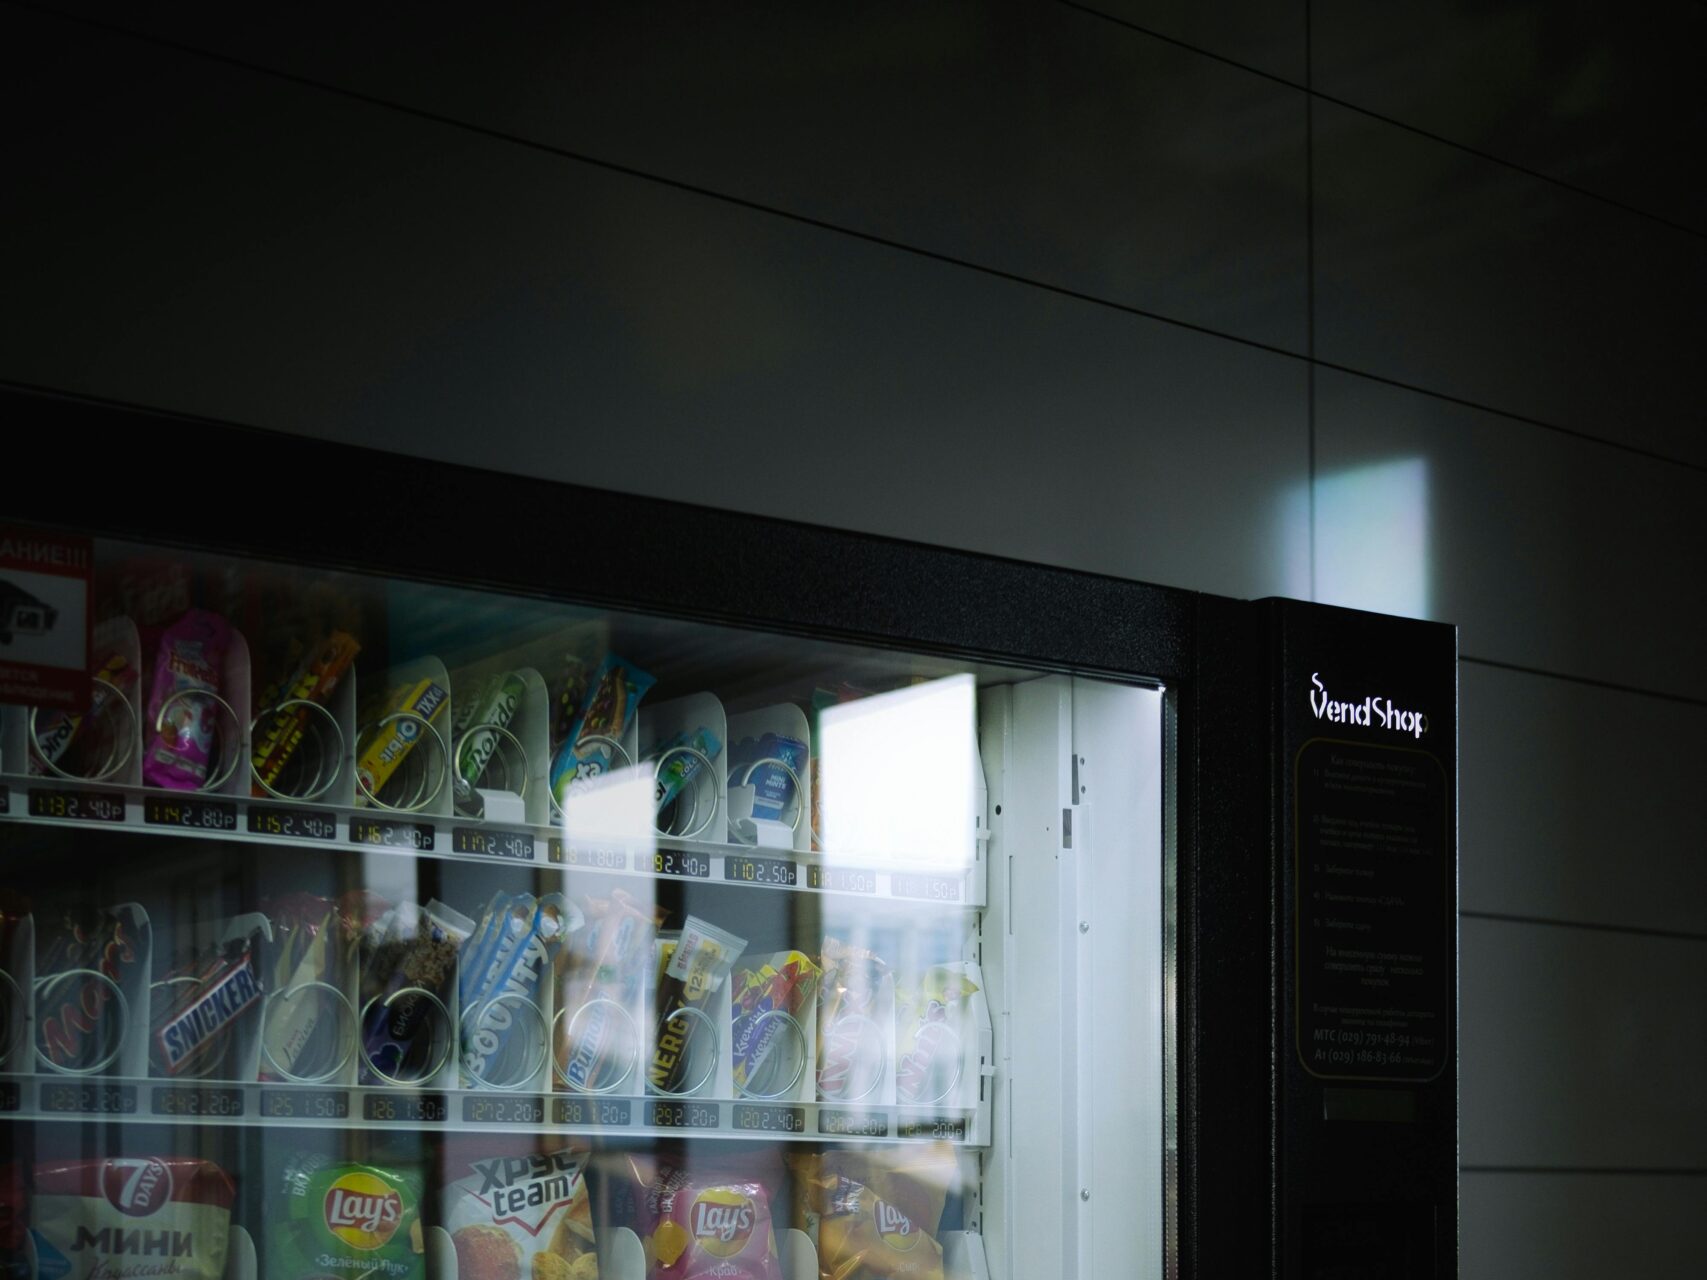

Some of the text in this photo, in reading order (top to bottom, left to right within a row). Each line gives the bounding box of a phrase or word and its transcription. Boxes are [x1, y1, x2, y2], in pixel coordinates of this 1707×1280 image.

[1309, 672, 1430, 739] VendShop
[463, 932, 549, 1076] BOUNTY
[112, 1159, 153, 1208] 7
[135, 1162, 164, 1207] DAYS
[494, 1175, 569, 1217] team
[330, 1189, 398, 1232] Lay's
[696, 1202, 753, 1242] Lay's
[70, 1226, 193, 1257] МИНИ
